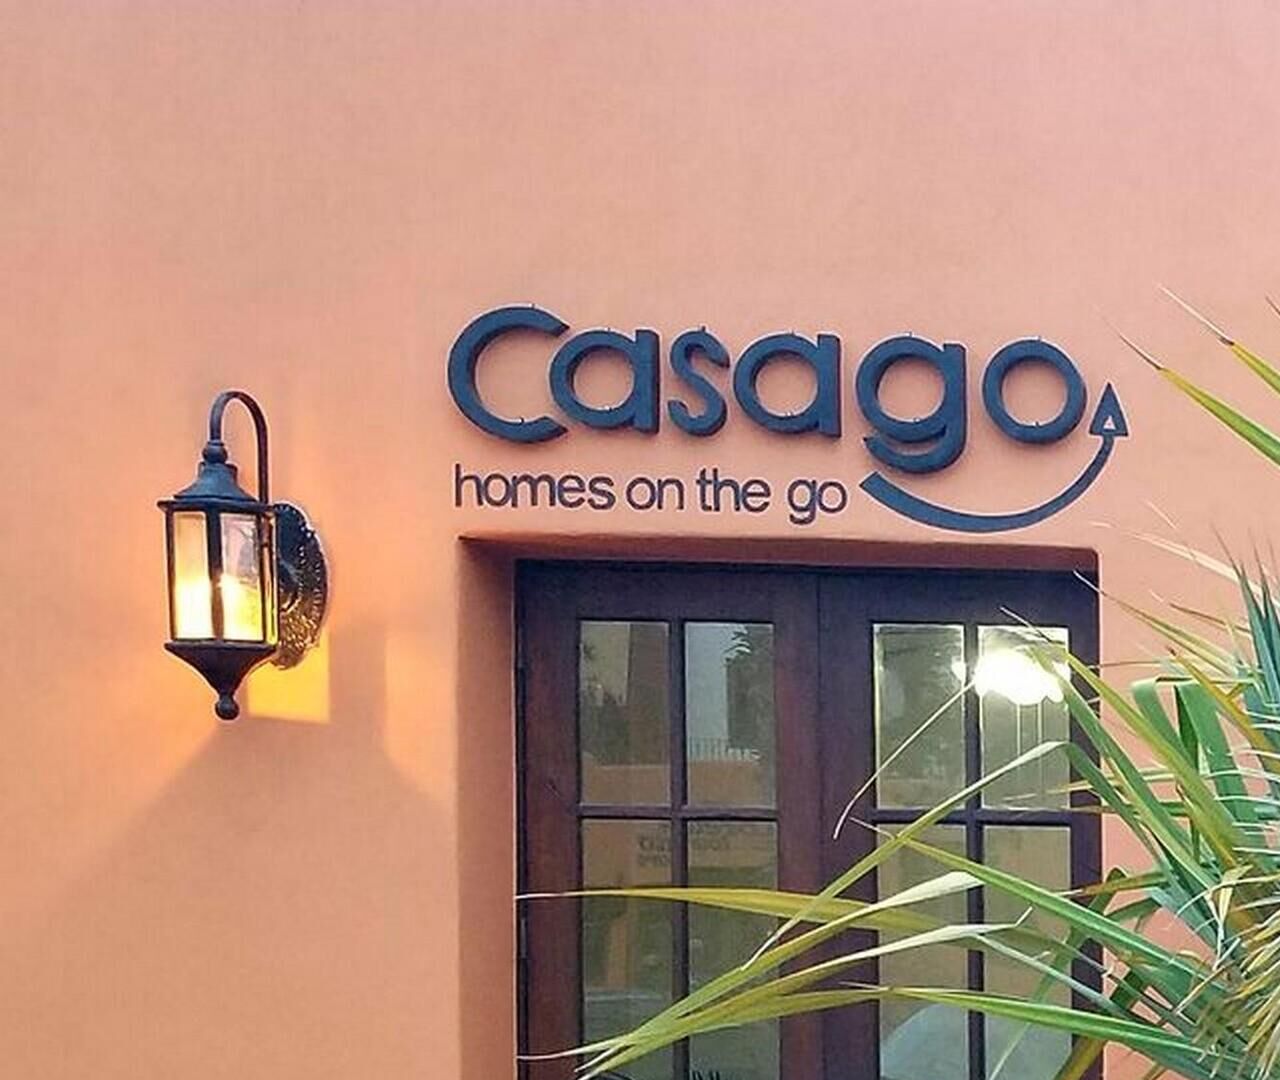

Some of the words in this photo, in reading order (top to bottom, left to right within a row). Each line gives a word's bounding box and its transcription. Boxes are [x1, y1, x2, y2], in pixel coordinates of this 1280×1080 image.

[447, 304, 1088, 475] Casago
[454, 464, 614, 512] homes
[625, 475, 685, 511] on
[695, 470, 771, 513] the
[787, 475, 848, 524] go
